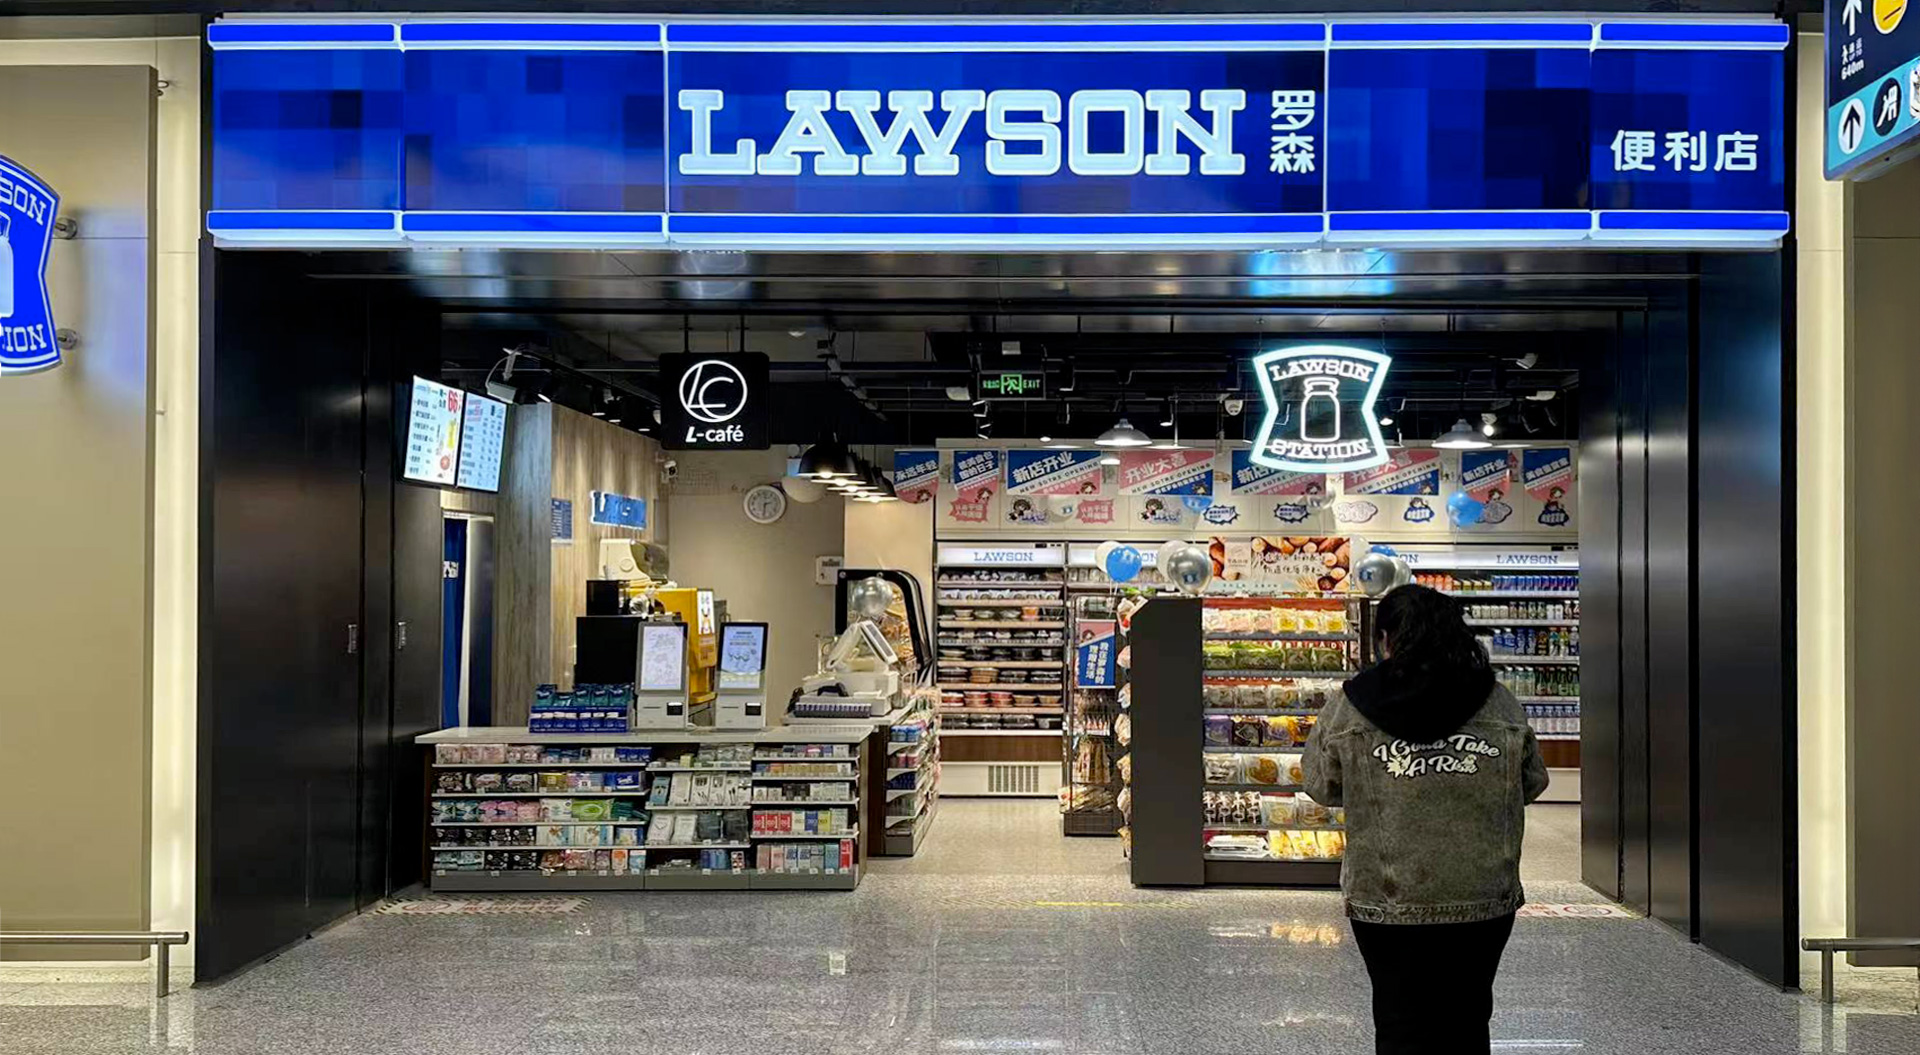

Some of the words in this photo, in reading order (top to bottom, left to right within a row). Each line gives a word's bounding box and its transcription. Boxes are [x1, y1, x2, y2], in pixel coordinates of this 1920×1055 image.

[1841, 59, 1865, 81] 640m
[678, 89, 1246, 176] LAWSON
[1270, 90, 1316, 174] 罗森
[1610, 130, 1760, 172] 便利店
[0, 171, 48, 226] SON
[0, 323, 48, 353] ION
[1268, 358, 1374, 382] LAWSON
[1023, 379, 1041, 389] EXIT
[685, 425, 745, 443] L-café
[1270, 438, 1372, 459] STATION
[1012, 451, 1076, 483] 新店开业
[1236, 465, 1279, 484] 新店
[973, 552, 1034, 562] LAWSON
[1496, 554, 1559, 565] LAWSON
[1373, 744, 1388, 762] I
[1448, 734, 1501, 757] Take
[1405, 757, 1427, 777] A
